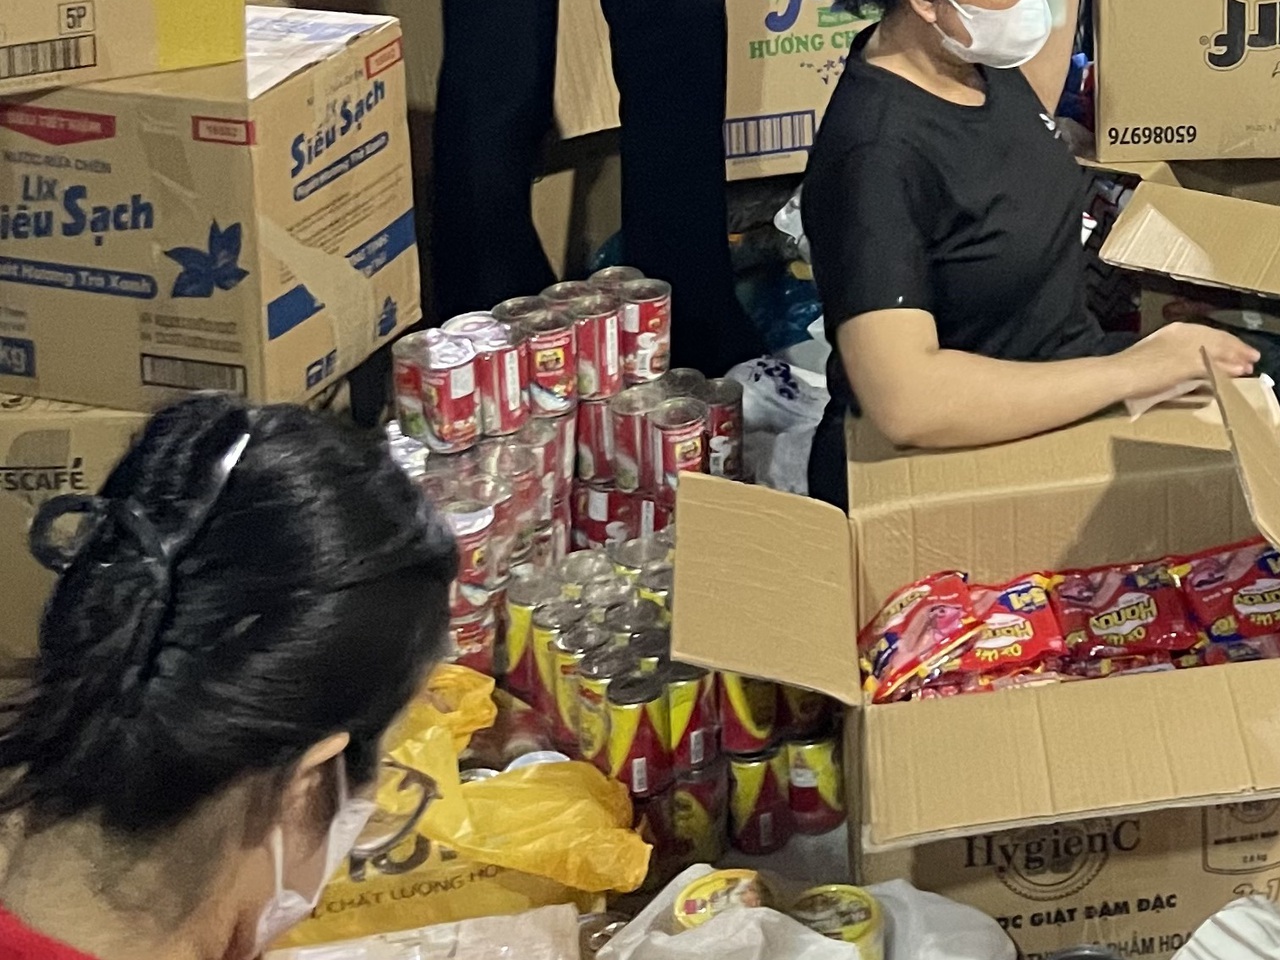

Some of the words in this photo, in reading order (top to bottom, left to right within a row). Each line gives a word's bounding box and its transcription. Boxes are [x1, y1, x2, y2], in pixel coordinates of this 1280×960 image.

[66, 6, 86, 29] 5P
[749, 33, 825, 59] HƯƠNG
[340, 80, 385, 136] Sạch
[1107, 124, 1198, 145] 65086976
[0, 204, 54, 239] iêu
[62, 184, 154, 246] Sạch
[0, 457, 88, 490] SCAFÉ
[964, 820, 1141, 874] HygienC
[1030, 908, 1077, 927] GIẶT
